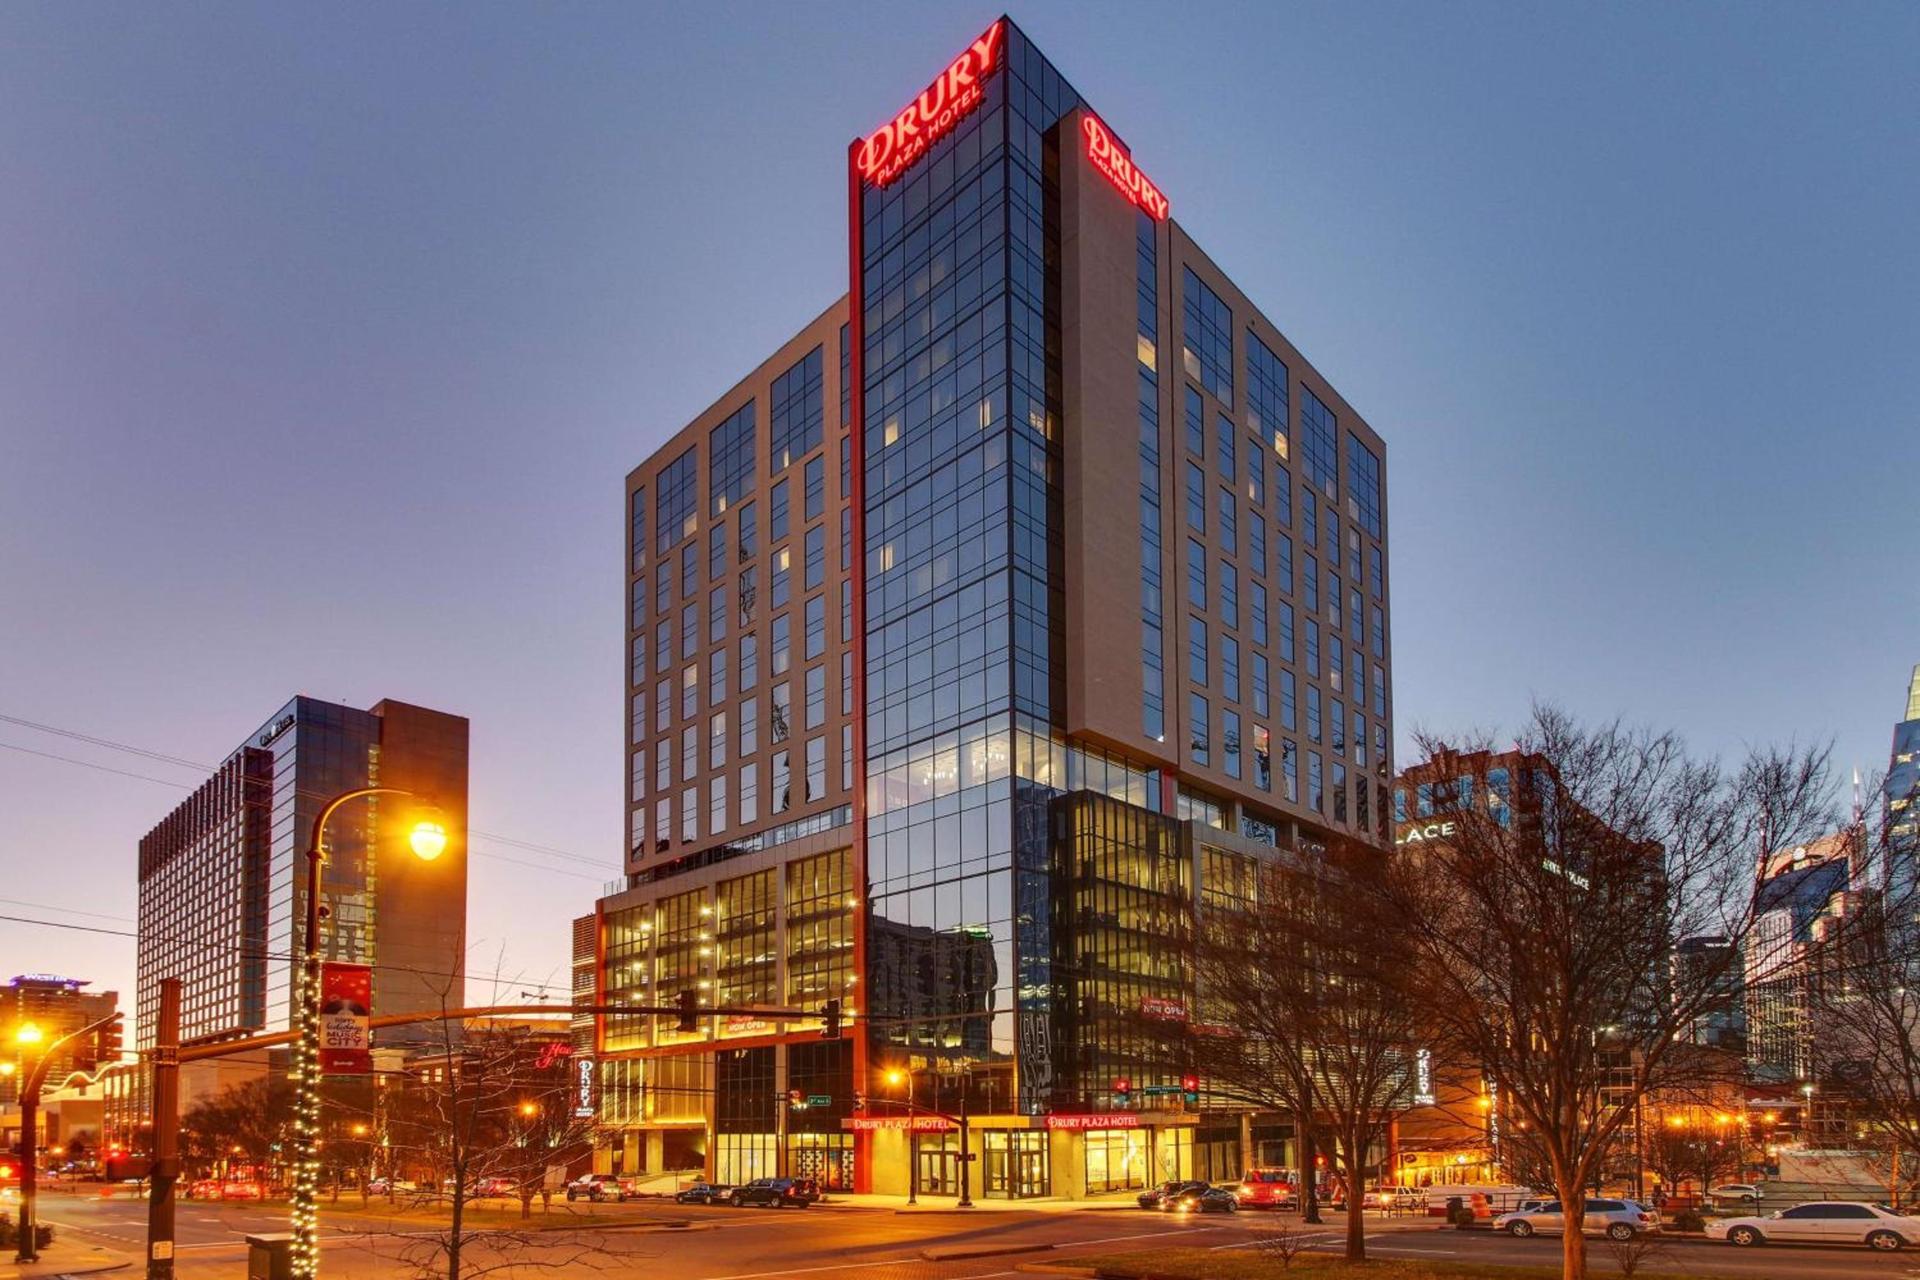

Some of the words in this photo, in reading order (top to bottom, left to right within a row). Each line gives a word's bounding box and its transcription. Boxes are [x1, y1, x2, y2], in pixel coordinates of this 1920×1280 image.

[857, 22, 999, 178] DRURY
[877, 136, 925, 185] PLAZA
[928, 85, 980, 138] HOTEL
[1084, 117, 1168, 219] DRURY
[1089, 149, 1115, 178] PLAZA
[1113, 176, 1138, 204] HOTEL
[327, 1037, 362, 1046] CITY
[855, 1120, 882, 1129] DRURY
[918, 1120, 949, 1129] HOTEL
[1048, 1116, 1080, 1128] DRURY
[1081, 1117, 1109, 1127] PLAZA
[1111, 1116, 1138, 1126] HOTEL
